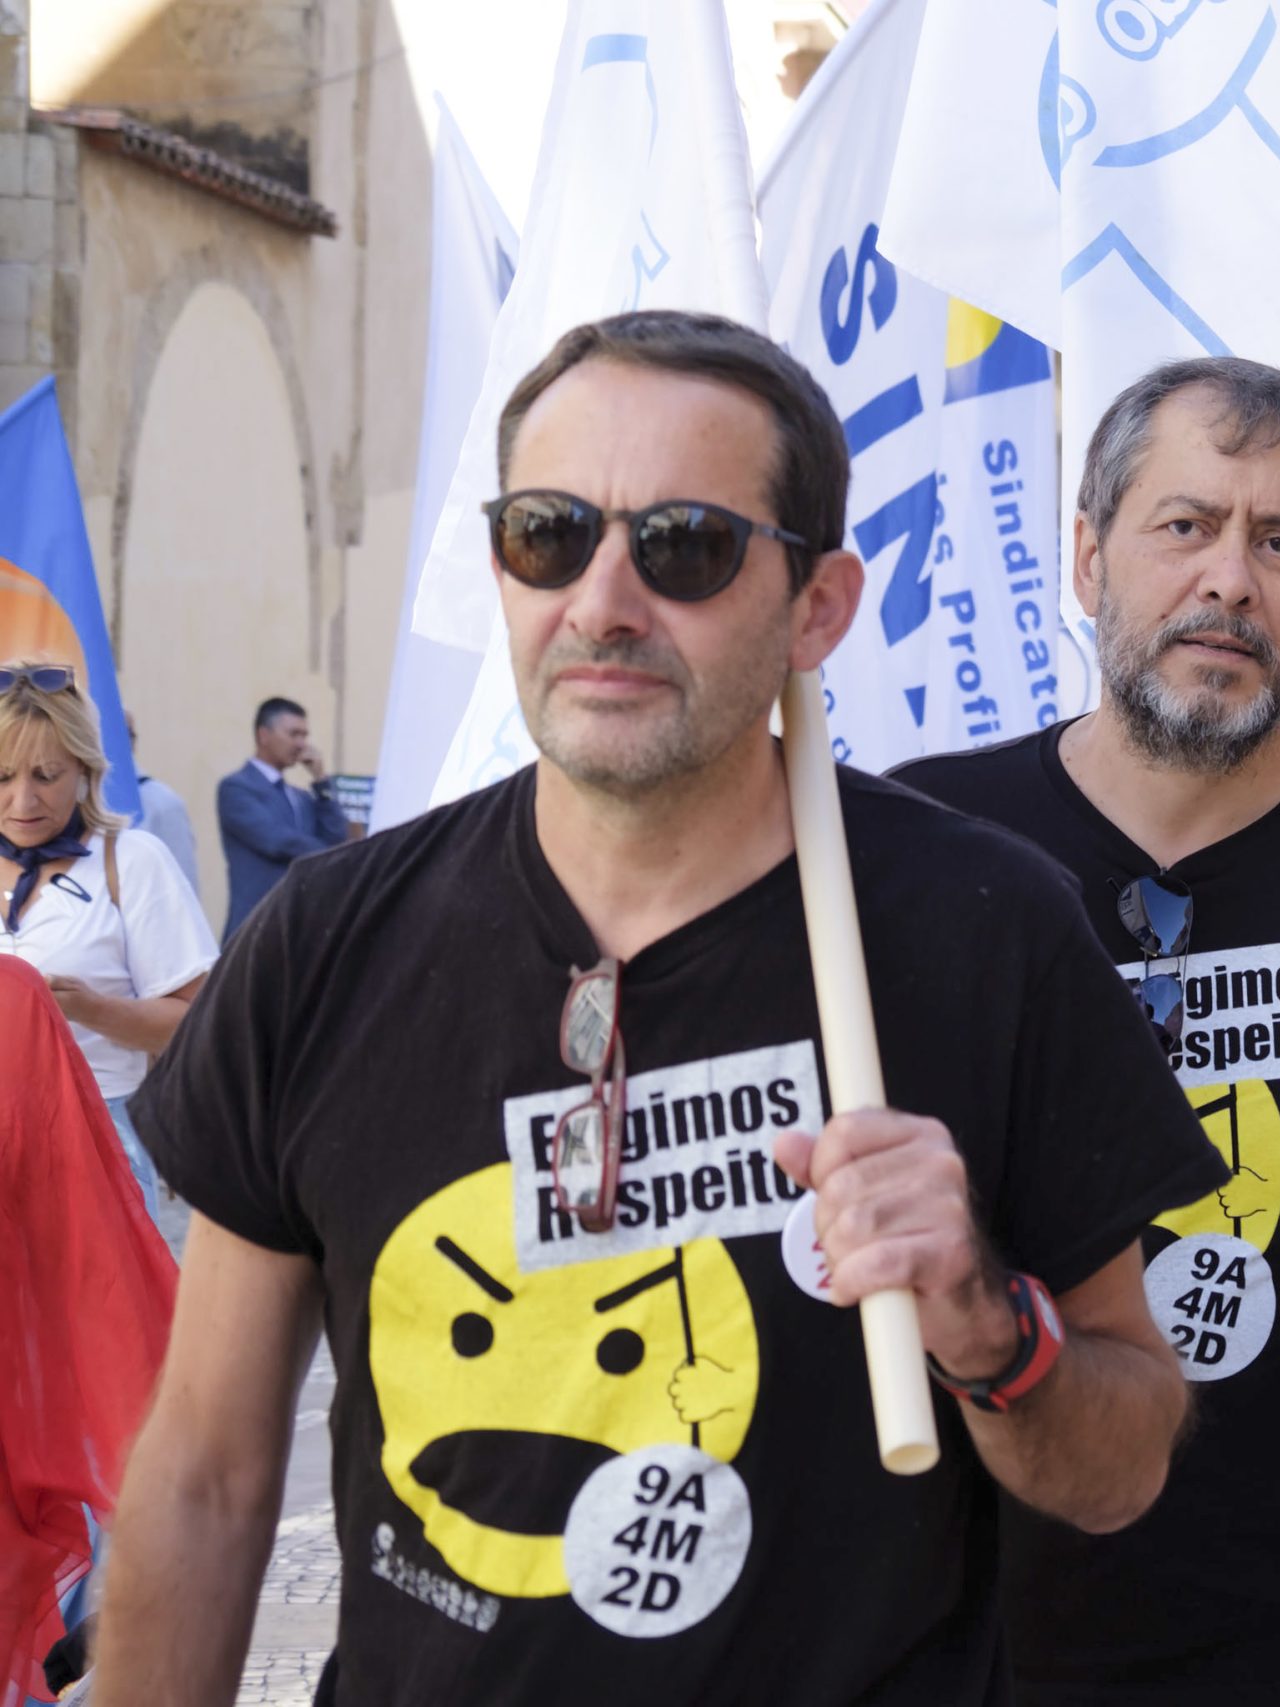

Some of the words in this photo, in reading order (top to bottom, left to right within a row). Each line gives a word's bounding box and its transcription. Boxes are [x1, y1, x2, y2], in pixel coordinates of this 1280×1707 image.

[939, 588, 1001, 746] Profi
[530, 1078, 800, 1173] Egimos
[537, 1148, 806, 1243] Rspeito
[1190, 1248, 1247, 1290] 9A
[1172, 1286, 1242, 1329] 4M
[1170, 1323, 1227, 1366] 2D
[633, 1464, 706, 1514] 9A
[612, 1515, 704, 1566] 4M
[600, 1566, 682, 1614] 2D
